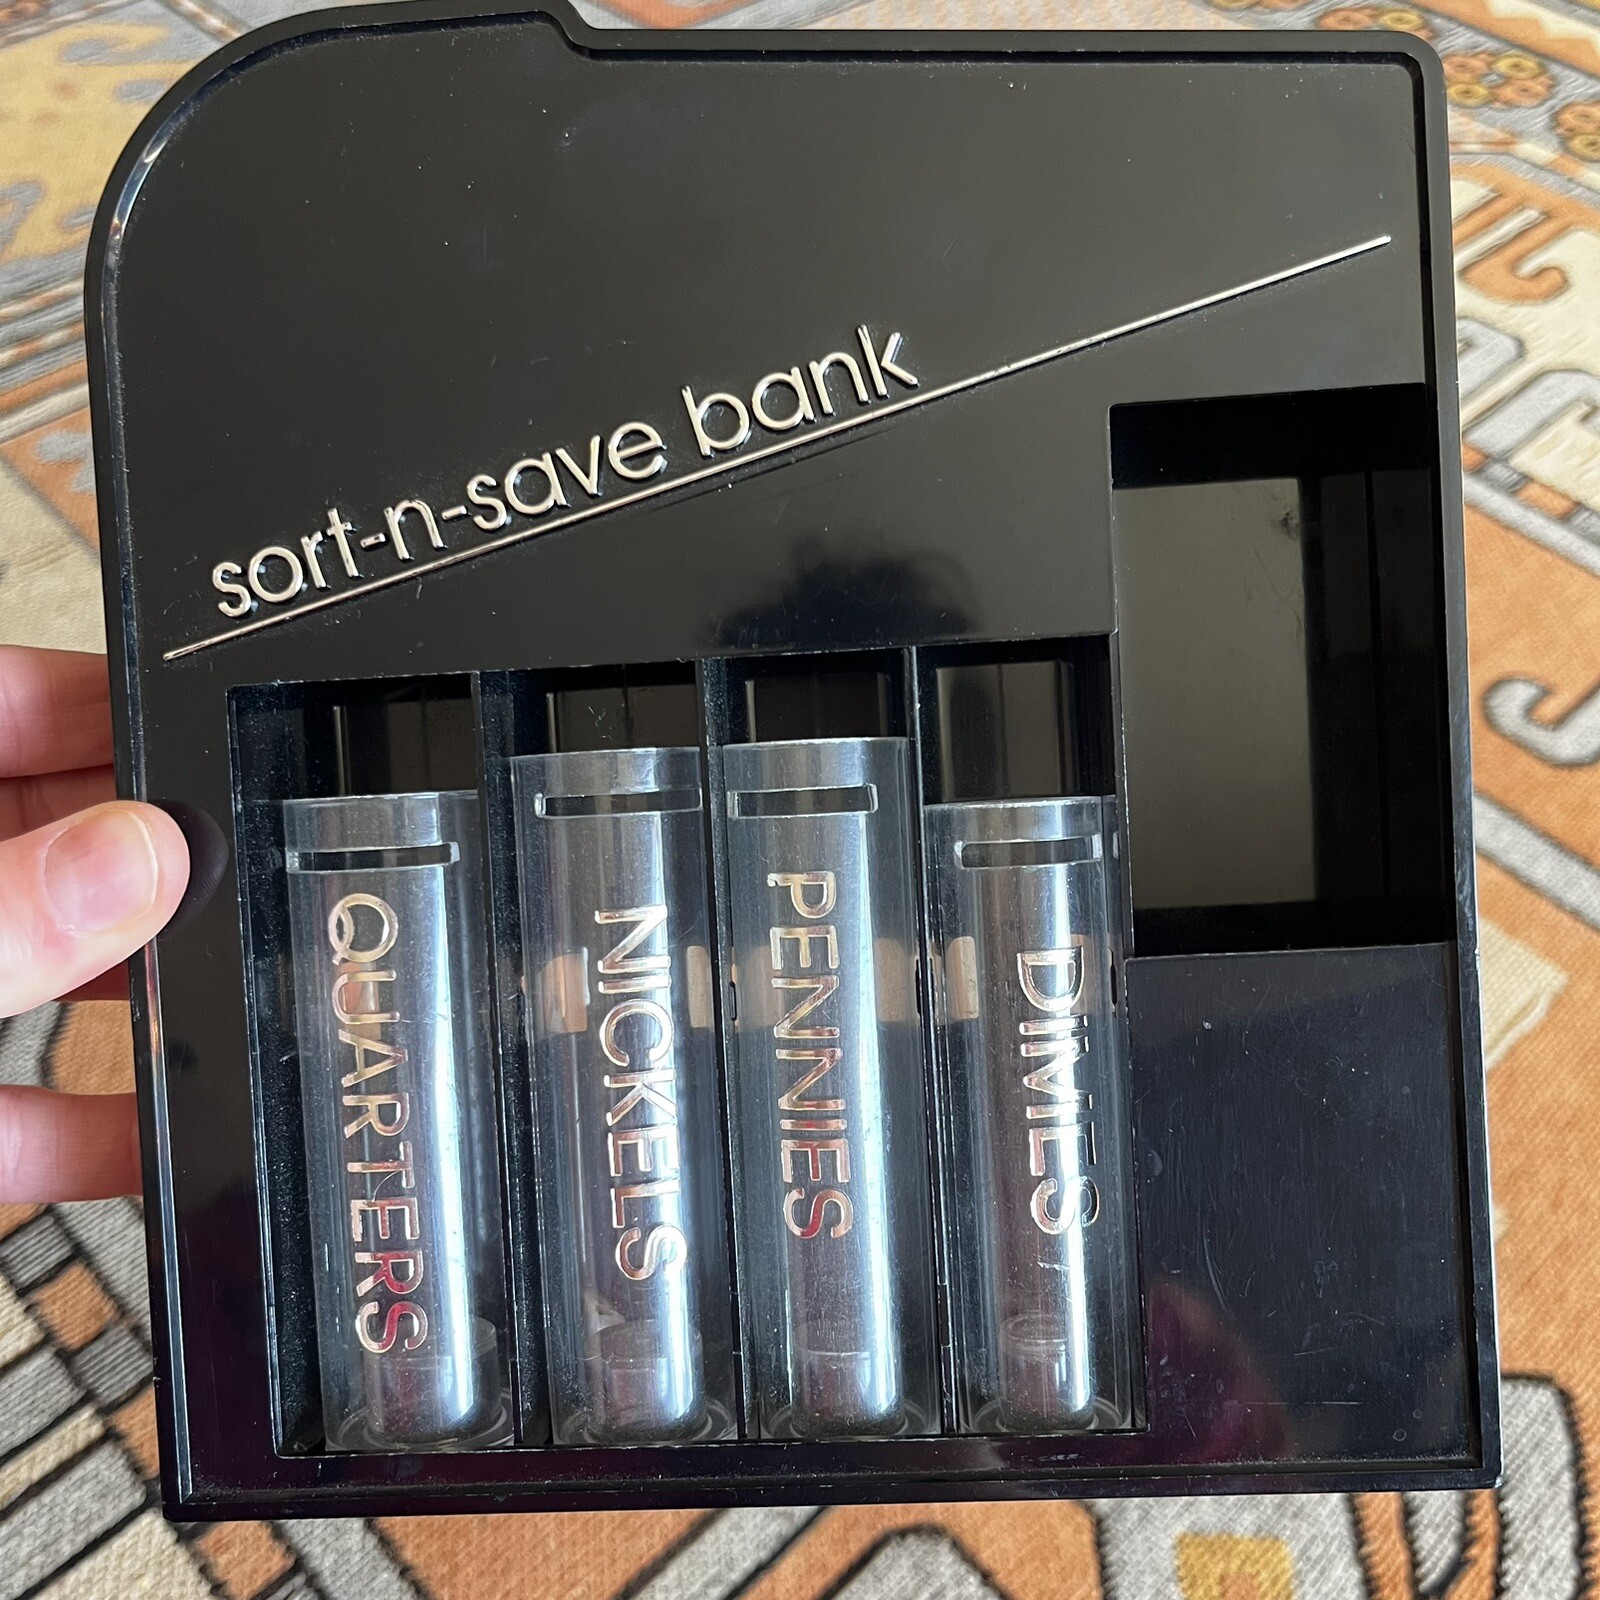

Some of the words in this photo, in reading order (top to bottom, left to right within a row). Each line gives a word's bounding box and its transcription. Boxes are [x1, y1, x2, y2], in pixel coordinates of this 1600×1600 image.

[211, 420, 668, 618] sort-n-save
[681, 324, 919, 457] bank
[328, 892, 428, 1354] QUARTERS
[593, 903, 688, 1282] NICKELS
[767, 871, 853, 1239] PENNIES
[1016, 945, 1100, 1236] DIMES
